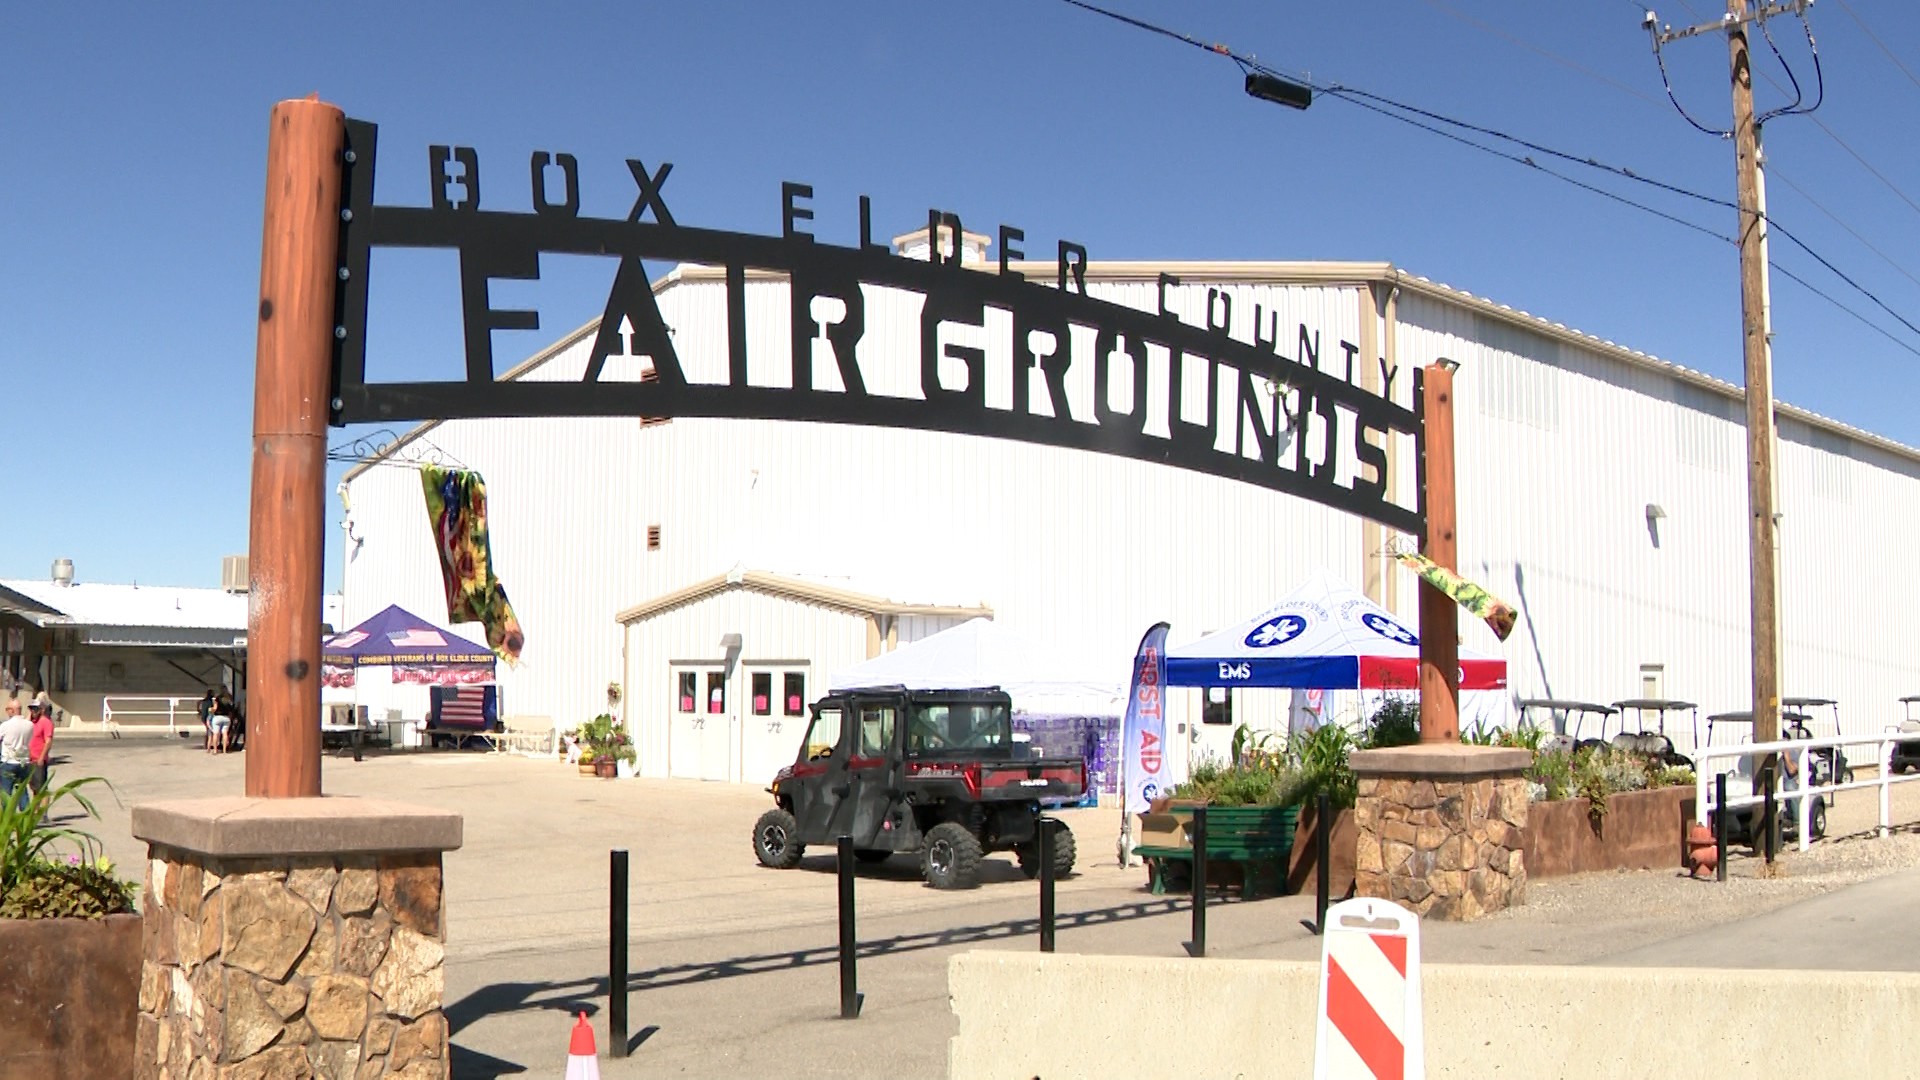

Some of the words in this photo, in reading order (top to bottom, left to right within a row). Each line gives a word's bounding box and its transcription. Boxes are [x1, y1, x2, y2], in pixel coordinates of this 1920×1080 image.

[429, 145, 676, 226] BOX
[782, 182, 1088, 297] ELDER
[1159, 273, 1398, 400] COUNTY
[1137, 647, 1161, 720] FIRST
[1218, 662, 1250, 680] EMS
[1140, 729, 1162, 775] AID
